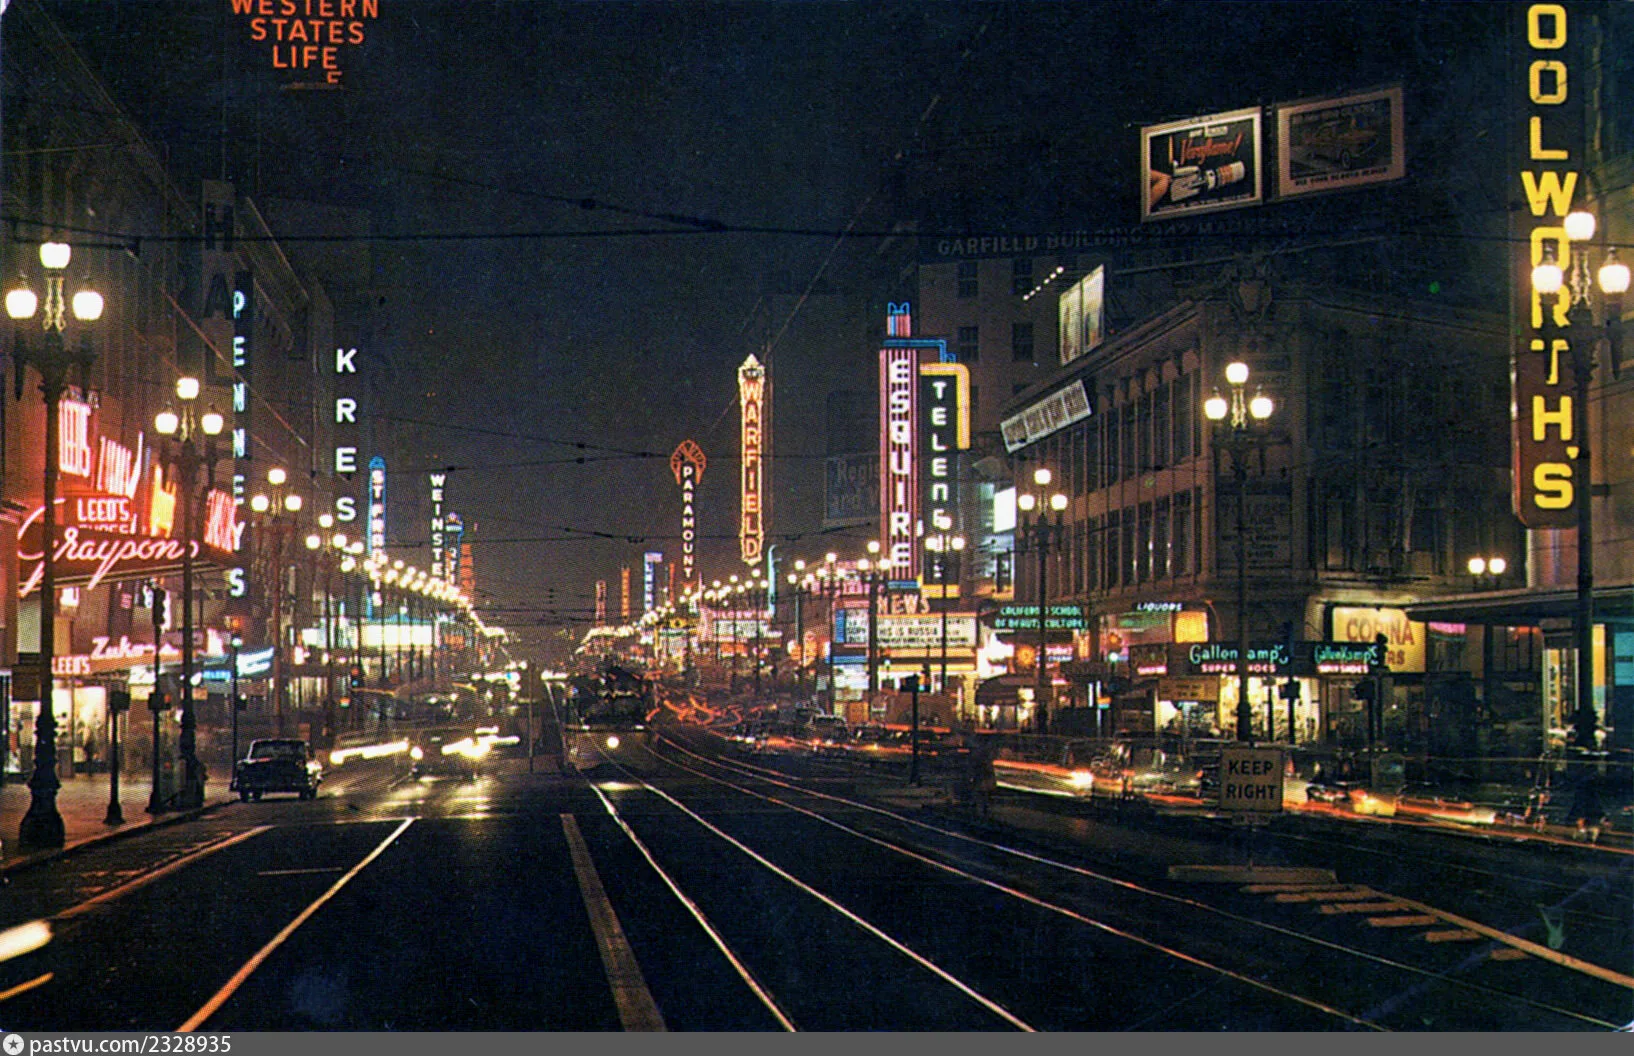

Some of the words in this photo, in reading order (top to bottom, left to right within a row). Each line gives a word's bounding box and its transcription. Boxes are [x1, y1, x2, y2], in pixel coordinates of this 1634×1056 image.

[231, 0, 379, 18] WESTERN
[250, 20, 365, 44] STATES
[272, 46, 338, 70] LIFE
[937, 235, 1038, 256] GARFIELD
[743, 382, 761, 558] WARFIELD
[889, 359, 910, 567] ESQUIRE
[682, 465, 695, 579] PARAMOUNT
[1228, 759, 1273, 776] KEEP
[1226, 783, 1277, 799] RIGHT
